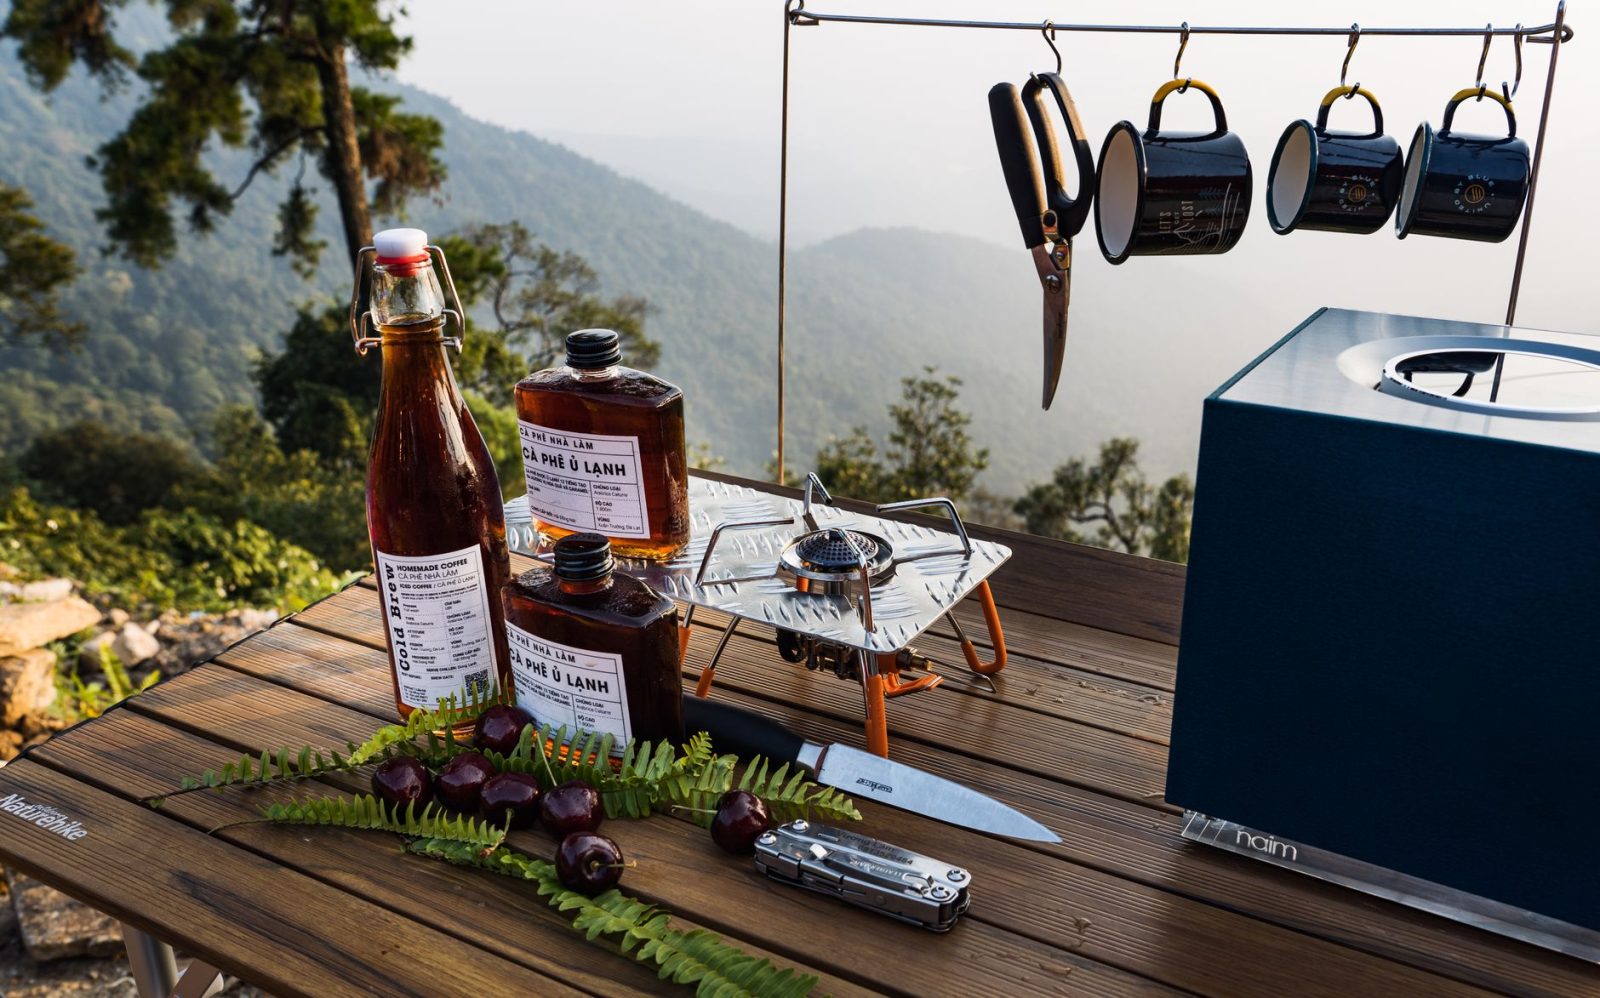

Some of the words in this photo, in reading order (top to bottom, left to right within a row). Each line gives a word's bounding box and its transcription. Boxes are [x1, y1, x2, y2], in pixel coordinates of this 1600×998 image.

[1468, 174, 1495, 187] BLUE
[1160, 211, 1171, 234] LET'S
[1182, 201, 1194, 220] LOST
[550, 436, 568, 446] NHÀ
[574, 440, 594, 450] LÀM
[523, 446, 538, 462] CÀ
[542, 454, 565, 469] PHÊ
[570, 455, 578, 471] Ủ
[584, 461, 626, 478] LẠNH
[441, 558, 467, 569] COFFEE
[385, 563, 402, 620] Brew
[394, 627, 410, 671] Cold
[533, 643, 552, 656] NHÀ
[556, 650, 576, 663] LÀM
[510, 648, 523, 666] CÀ
[526, 658, 548, 678] PHÊ
[552, 666, 561, 682] Ủ
[567, 673, 609, 694] LẠNH
[0, 794, 88, 840] Naturehike
[1236, 830, 1297, 861] naim
